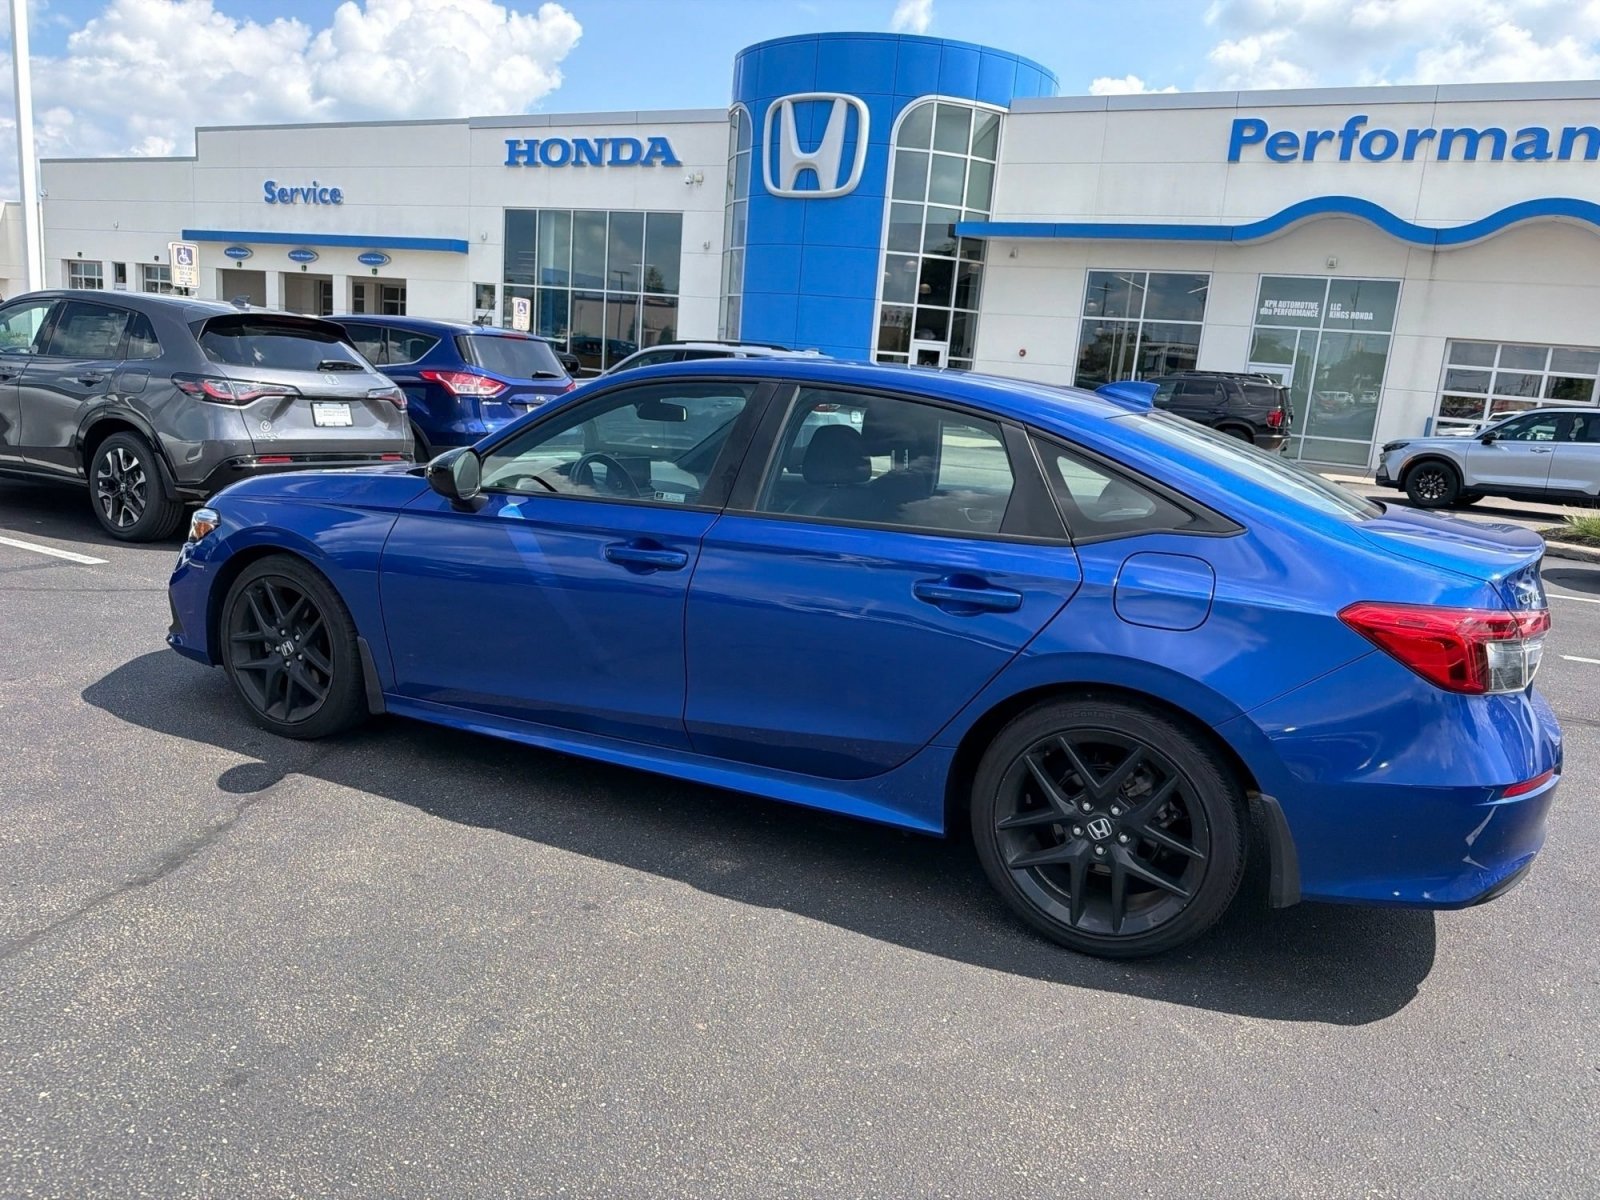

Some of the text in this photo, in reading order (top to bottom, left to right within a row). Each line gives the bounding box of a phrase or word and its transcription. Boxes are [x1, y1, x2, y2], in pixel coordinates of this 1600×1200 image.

[1228, 115, 1600, 162] Performan
[504, 136, 682, 168] HONDA
[264, 180, 343, 204] Service
[1273, 308, 1319, 318] PERFORMANCE
[1329, 311, 1350, 319] KINGS
[1350, 312, 1373, 320] HONDA
[1330, 303, 1342, 311] LLC
